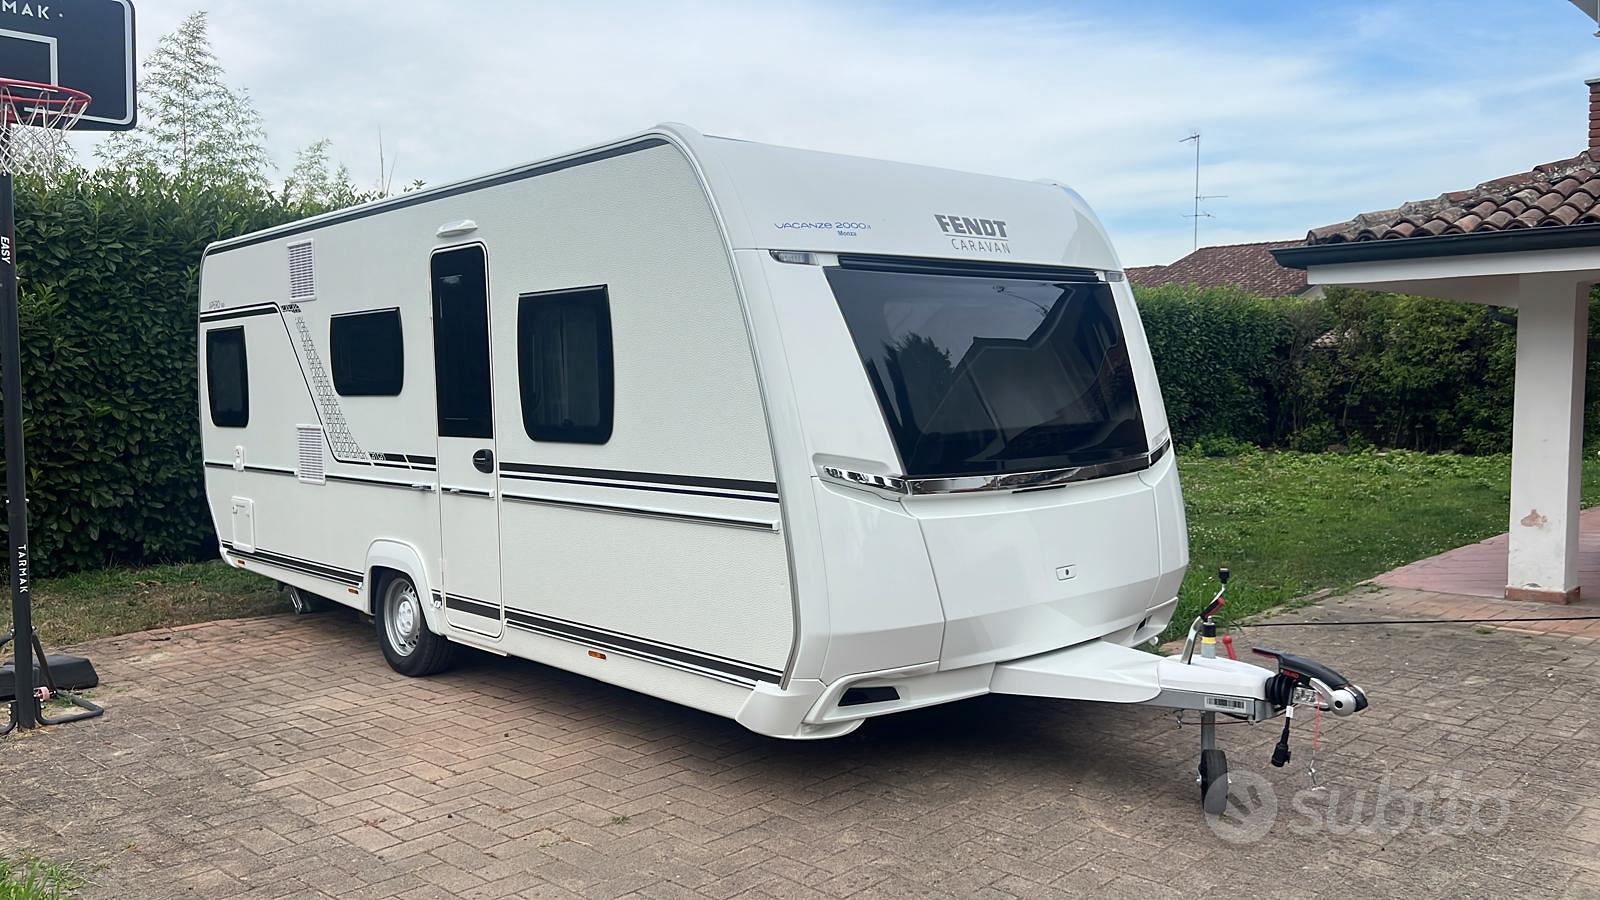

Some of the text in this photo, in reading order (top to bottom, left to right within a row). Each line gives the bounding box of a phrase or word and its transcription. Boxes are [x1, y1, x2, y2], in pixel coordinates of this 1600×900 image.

[934, 214, 1007, 238] FENDT
[0, 235, 11, 265] EASY
[951, 238, 1010, 254] CARAVAN
[17, 544, 29, 593] TARMAK
